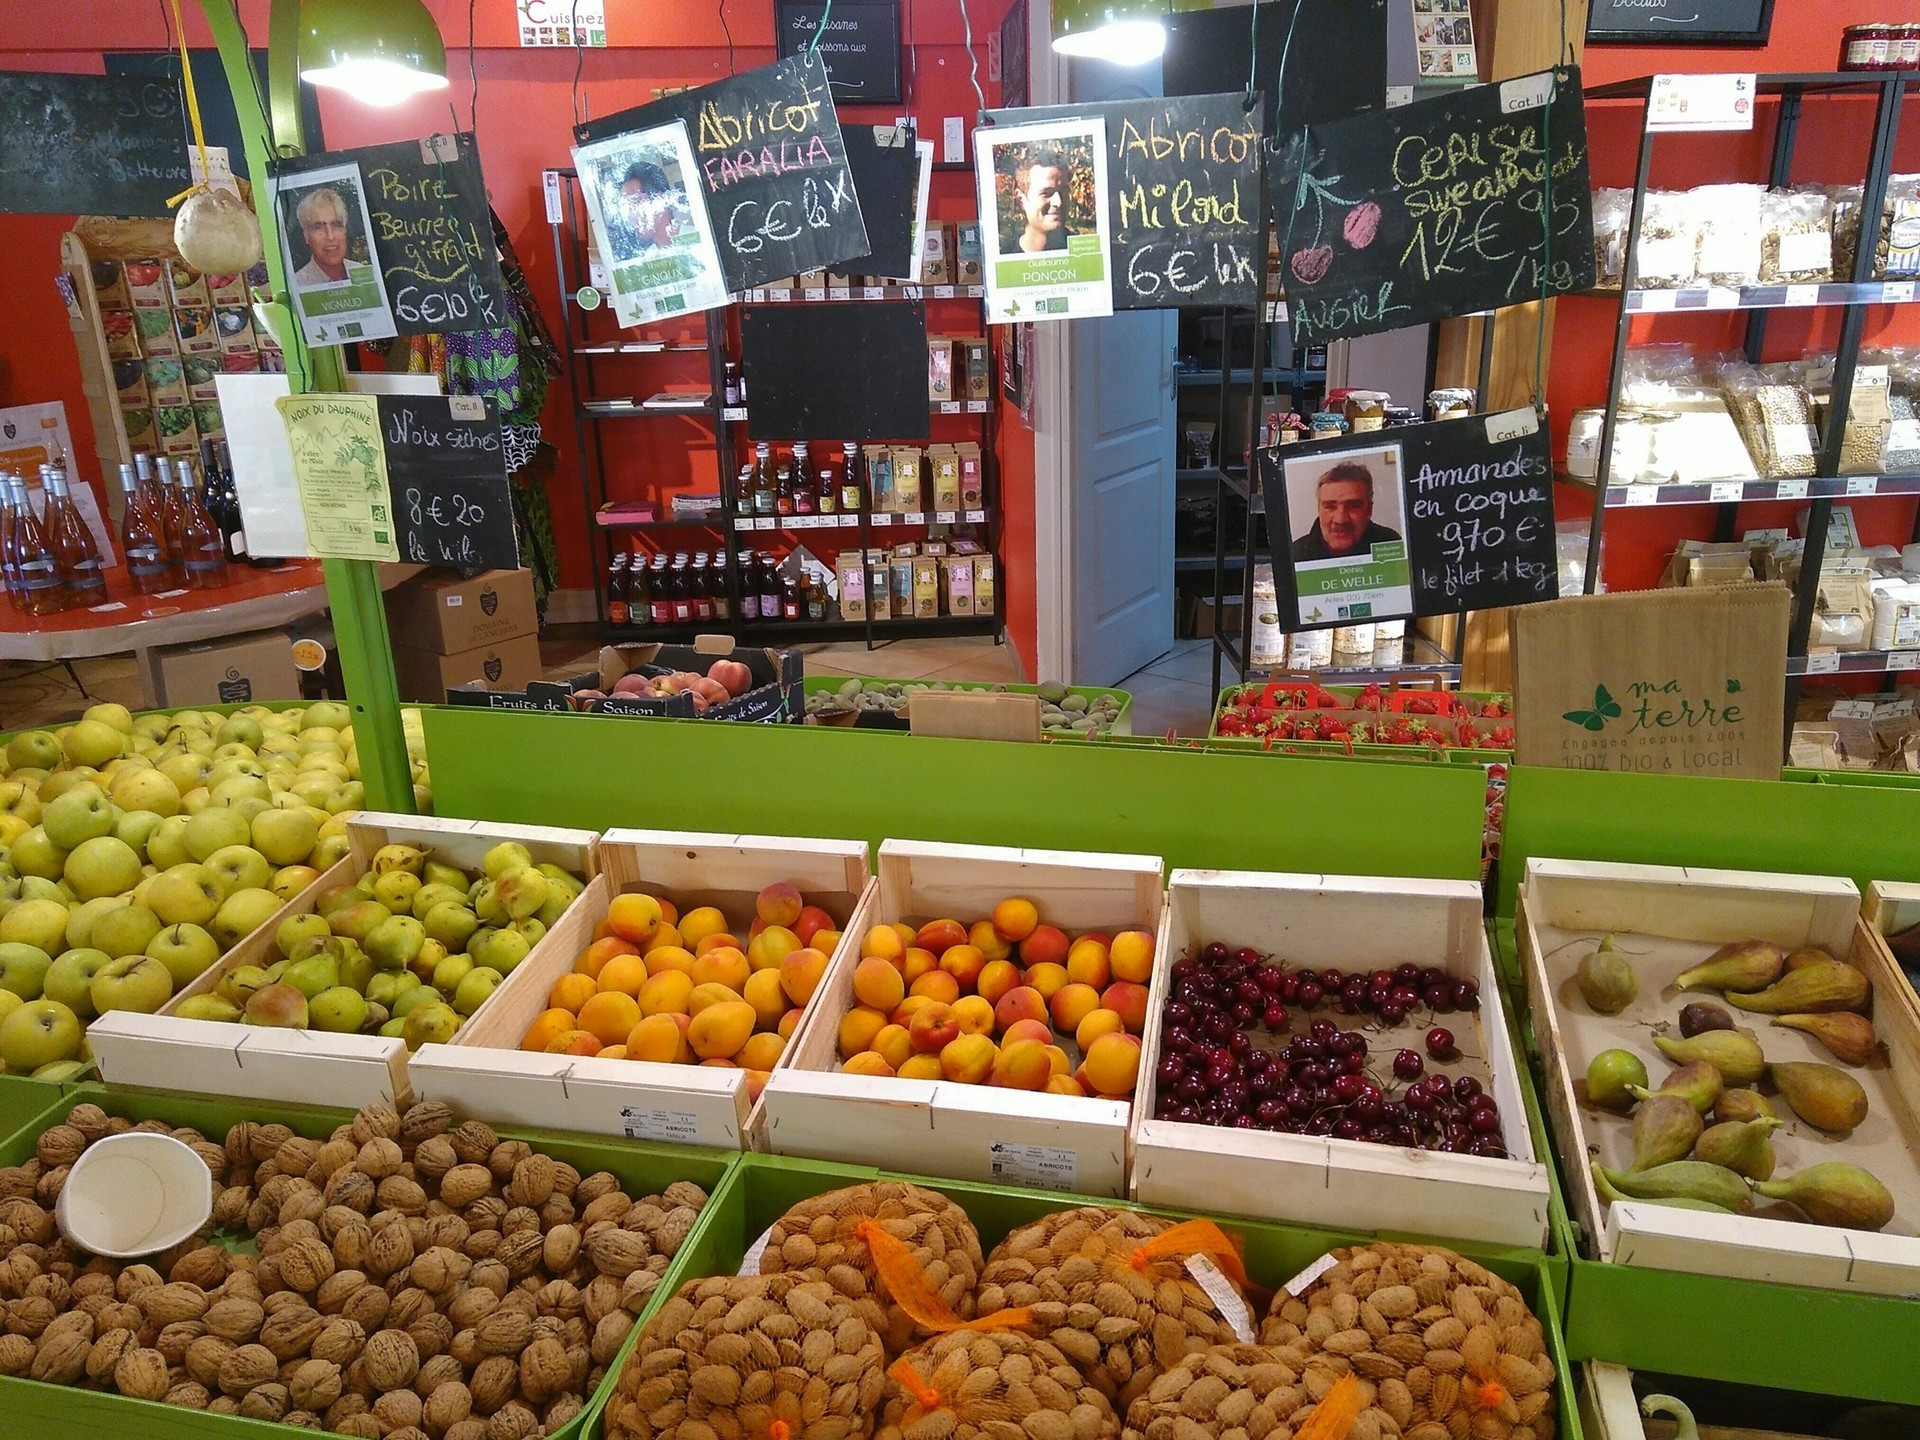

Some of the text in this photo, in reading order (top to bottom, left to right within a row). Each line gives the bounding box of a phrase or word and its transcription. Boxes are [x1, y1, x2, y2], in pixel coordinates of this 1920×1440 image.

[525, 0, 604, 24] Cuisnez
[792, 15, 817, 29] Les
[797, 39, 808, 52] et
[815, 43, 849, 52] oissons
[699, 98, 821, 151] Abricot
[703, 135, 833, 192] FARALIA
[1022, 269, 1077, 284] PONÇON
[321, 297, 362, 311] VIGNAUD
[290, 406, 311, 423] NOIX
[312, 405, 324, 415] DU
[389, 408, 441, 446] Noix
[1410, 444, 1547, 494] Amandes
[1413, 486, 1547, 520] en coque
[1339, 566, 1364, 575] Denis
[1321, 574, 1385, 591] DE WELLE
[1422, 568, 1438, 589] le
[1444, 565, 1484, 596] filet
[1626, 679, 1682, 699] ma
[489, 695, 560, 711] Fruits de
[603, 701, 654, 716] Saison
[1627, 698, 1745, 734] terre
[1639, 733, 1695, 746] depuis
[1706, 731, 1745, 742] 2009
